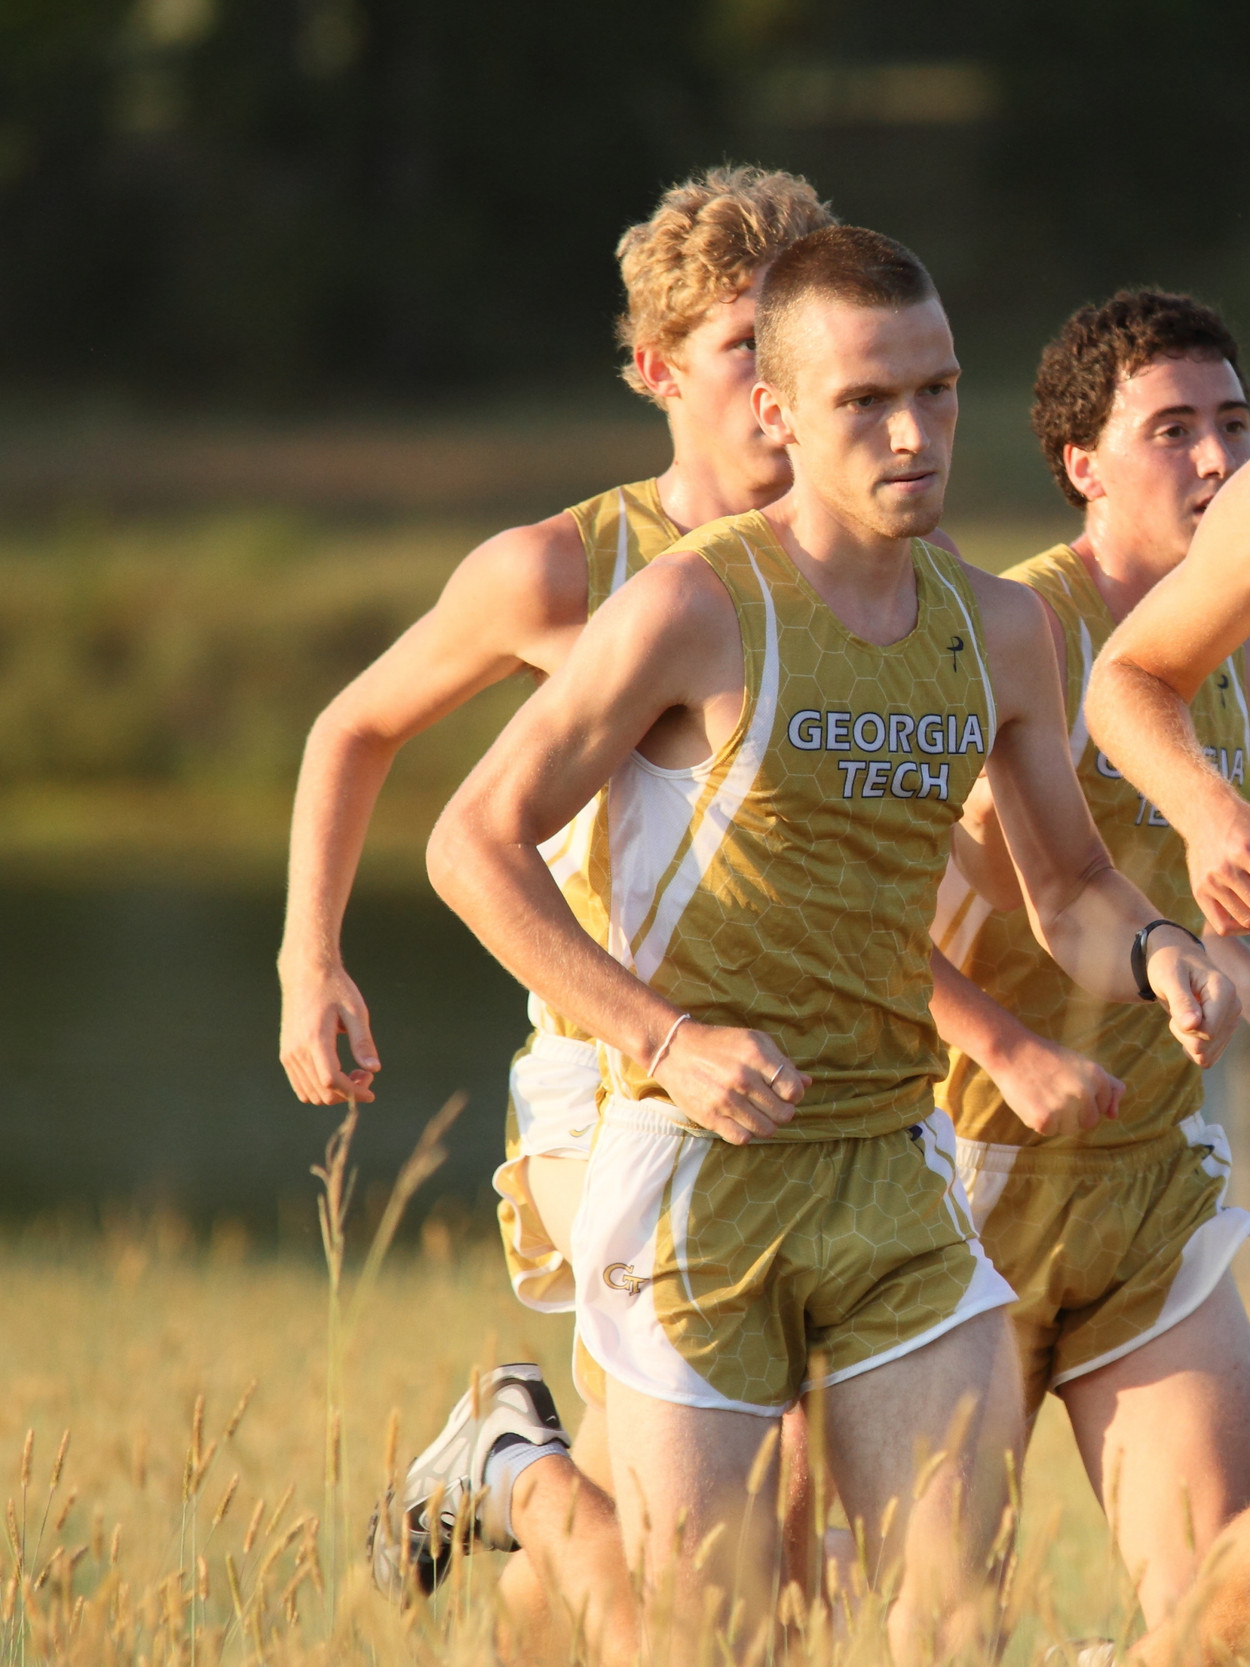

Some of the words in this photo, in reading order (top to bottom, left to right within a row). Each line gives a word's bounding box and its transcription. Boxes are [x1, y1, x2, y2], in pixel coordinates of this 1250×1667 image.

[787, 709, 985, 755] GEORGIA
[838, 760, 949, 802] TECH
[603, 1262, 651, 1296] GT
